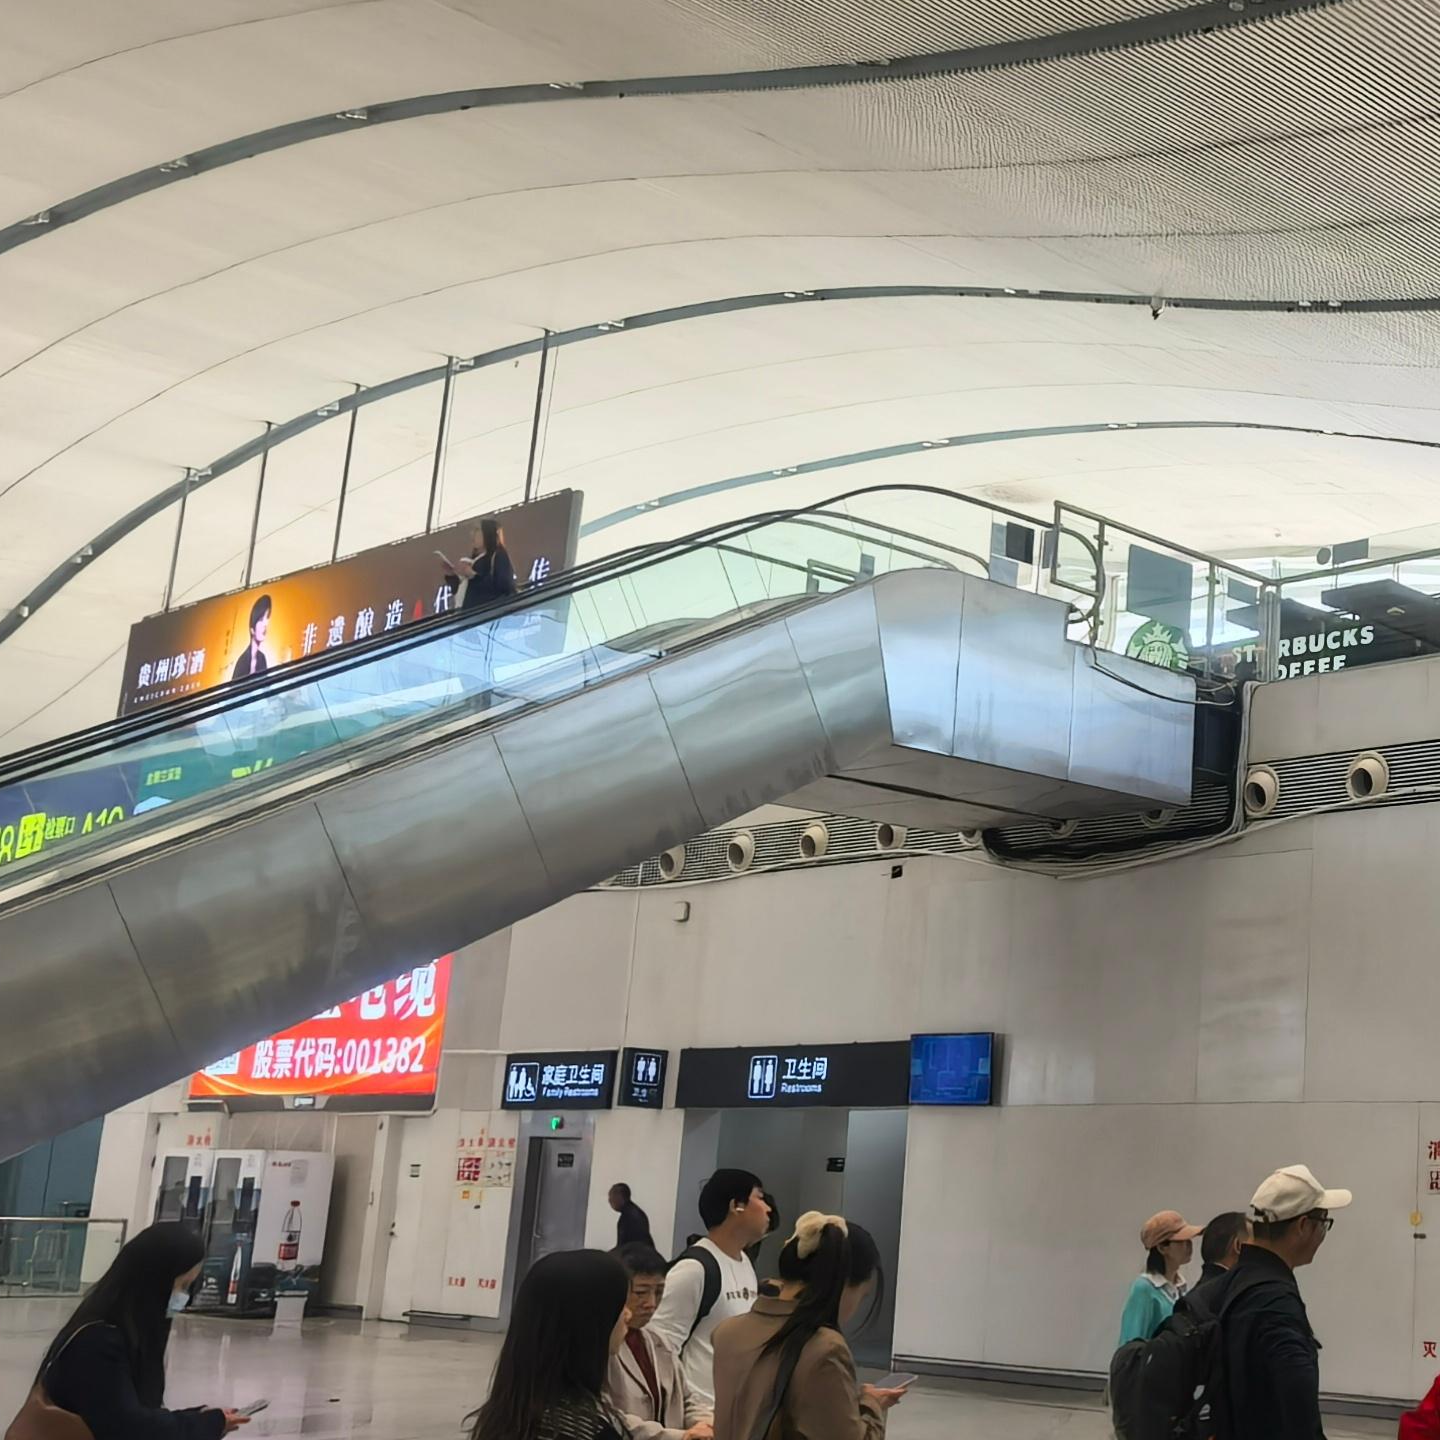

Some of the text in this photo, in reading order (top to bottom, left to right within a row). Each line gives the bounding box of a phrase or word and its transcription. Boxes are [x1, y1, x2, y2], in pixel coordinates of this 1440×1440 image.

[1231, 625, 1375, 664] STRBUCKS
[250, 1036, 427, 1079] 股票代码:001382
[781, 1056, 828, 1081] 卫生间
[541, 1063, 606, 1086] 家庭卫生间
